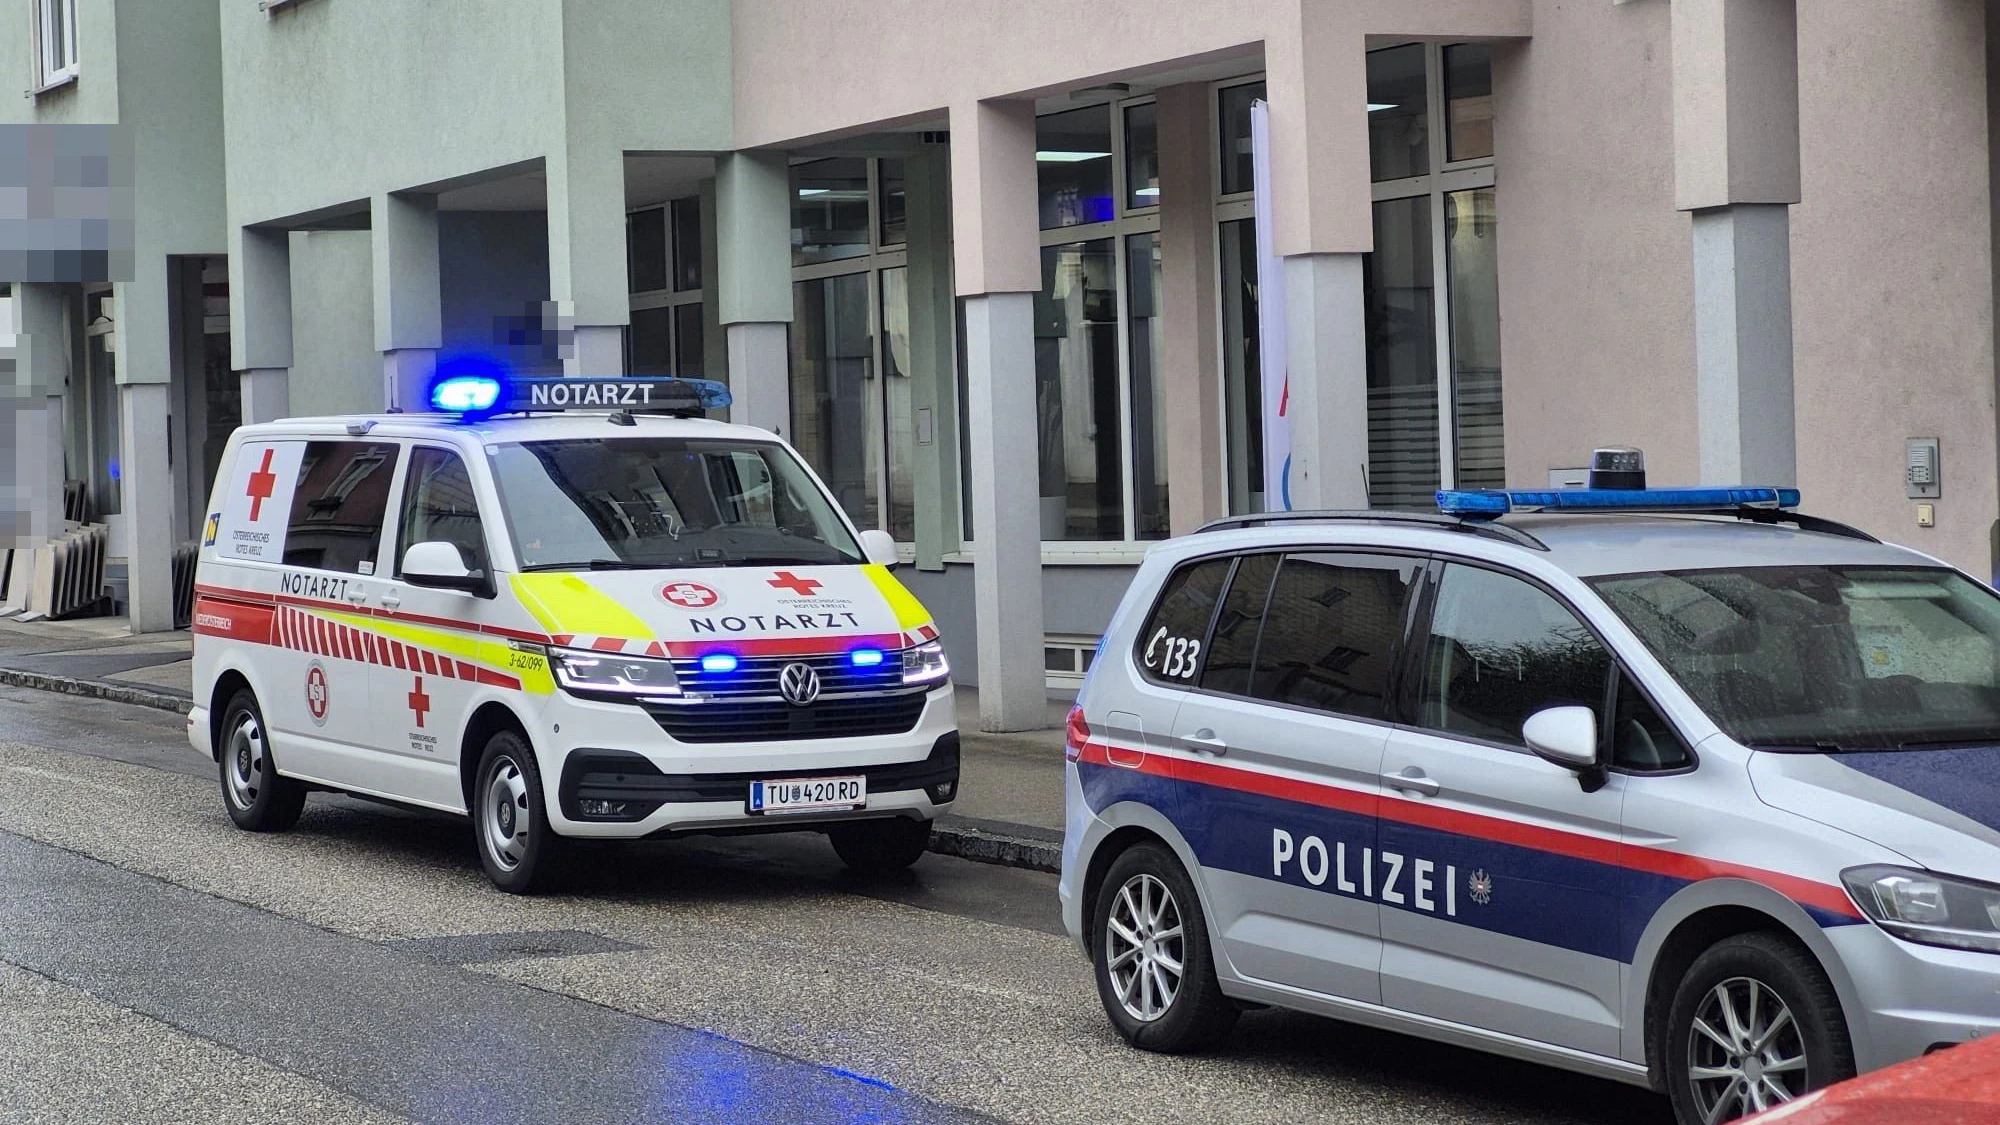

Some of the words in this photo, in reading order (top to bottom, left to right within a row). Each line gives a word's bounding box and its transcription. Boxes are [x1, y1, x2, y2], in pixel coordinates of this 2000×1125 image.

[531, 383, 654, 405] NOTARZT
[281, 573, 348, 599] NOTARZT
[689, 612, 862, 633] NOTARZT
[509, 653, 544, 671] 3-62/099
[1162, 637, 1200, 678] 133
[768, 785, 789, 804] TU
[804, 783, 834, 802] 420
[839, 781, 859, 800] RD
[1273, 828, 1455, 916] POLIZEI
